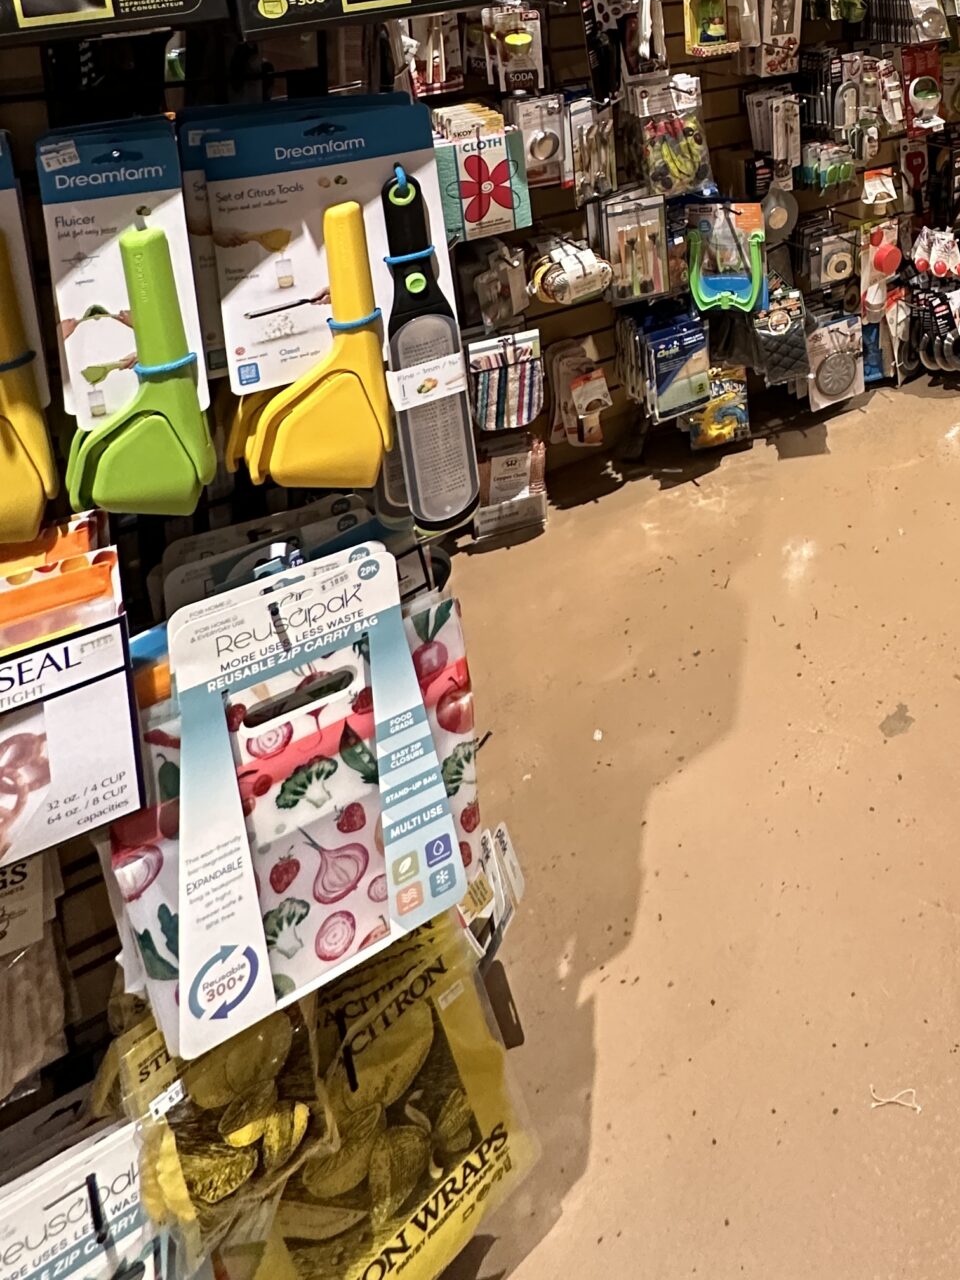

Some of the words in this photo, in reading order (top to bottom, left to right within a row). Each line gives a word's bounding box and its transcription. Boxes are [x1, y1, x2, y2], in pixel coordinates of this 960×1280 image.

[509, 72, 534, 81] SODA
[275, 137, 365, 161] Dreamfarm
[462, 137, 502, 153] CLOTH
[55, 164, 163, 190] Dreamfarm
[216, 191, 232, 203] Set
[234, 191, 244, 202] of
[247, 186, 275, 200] Citrus
[277, 183, 304, 194] Tools
[55, 215, 95, 228] Fluicer
[360, 563, 378, 576] 2PK
[207, 659, 276, 693] REUSABLE
[277, 648, 301, 665] ZIP
[304, 628, 351, 652] CARRY
[354, 615, 379, 632] BAG
[220, 653, 256, 672] MORE
[295, 626, 324, 643] LESS
[327, 609, 364, 630] WASTE
[0, 646, 82, 693] SEAL
[389, 711, 413, 726] FOOD
[389, 719, 414, 734] GRADE
[390, 749, 425, 769] CLOSURE
[391, 748, 407, 761] EASY
[407, 742, 422, 754] ZIP
[47, 800, 60, 813] 32
[101, 770, 126, 789] CUP
[385, 782, 423, 804] STAND-UP
[423, 773, 438, 786] BAG
[47, 813, 62, 826] 64
[102, 784, 128, 802] CUP
[77, 798, 129, 827] capacities
[390, 813, 422, 839] MULTI
[423, 804, 444, 822] USE
[186, 856, 243, 896] EXPANDABLE
[201, 961, 247, 991] Reusable
[206, 973, 246, 1003] 300+
[350, 953, 448, 1056] CITRON
[410, 1121, 509, 1233] WRAPS
[32, 1238, 68, 1268] USES
[53, 1249, 80, 1278] ZIP
